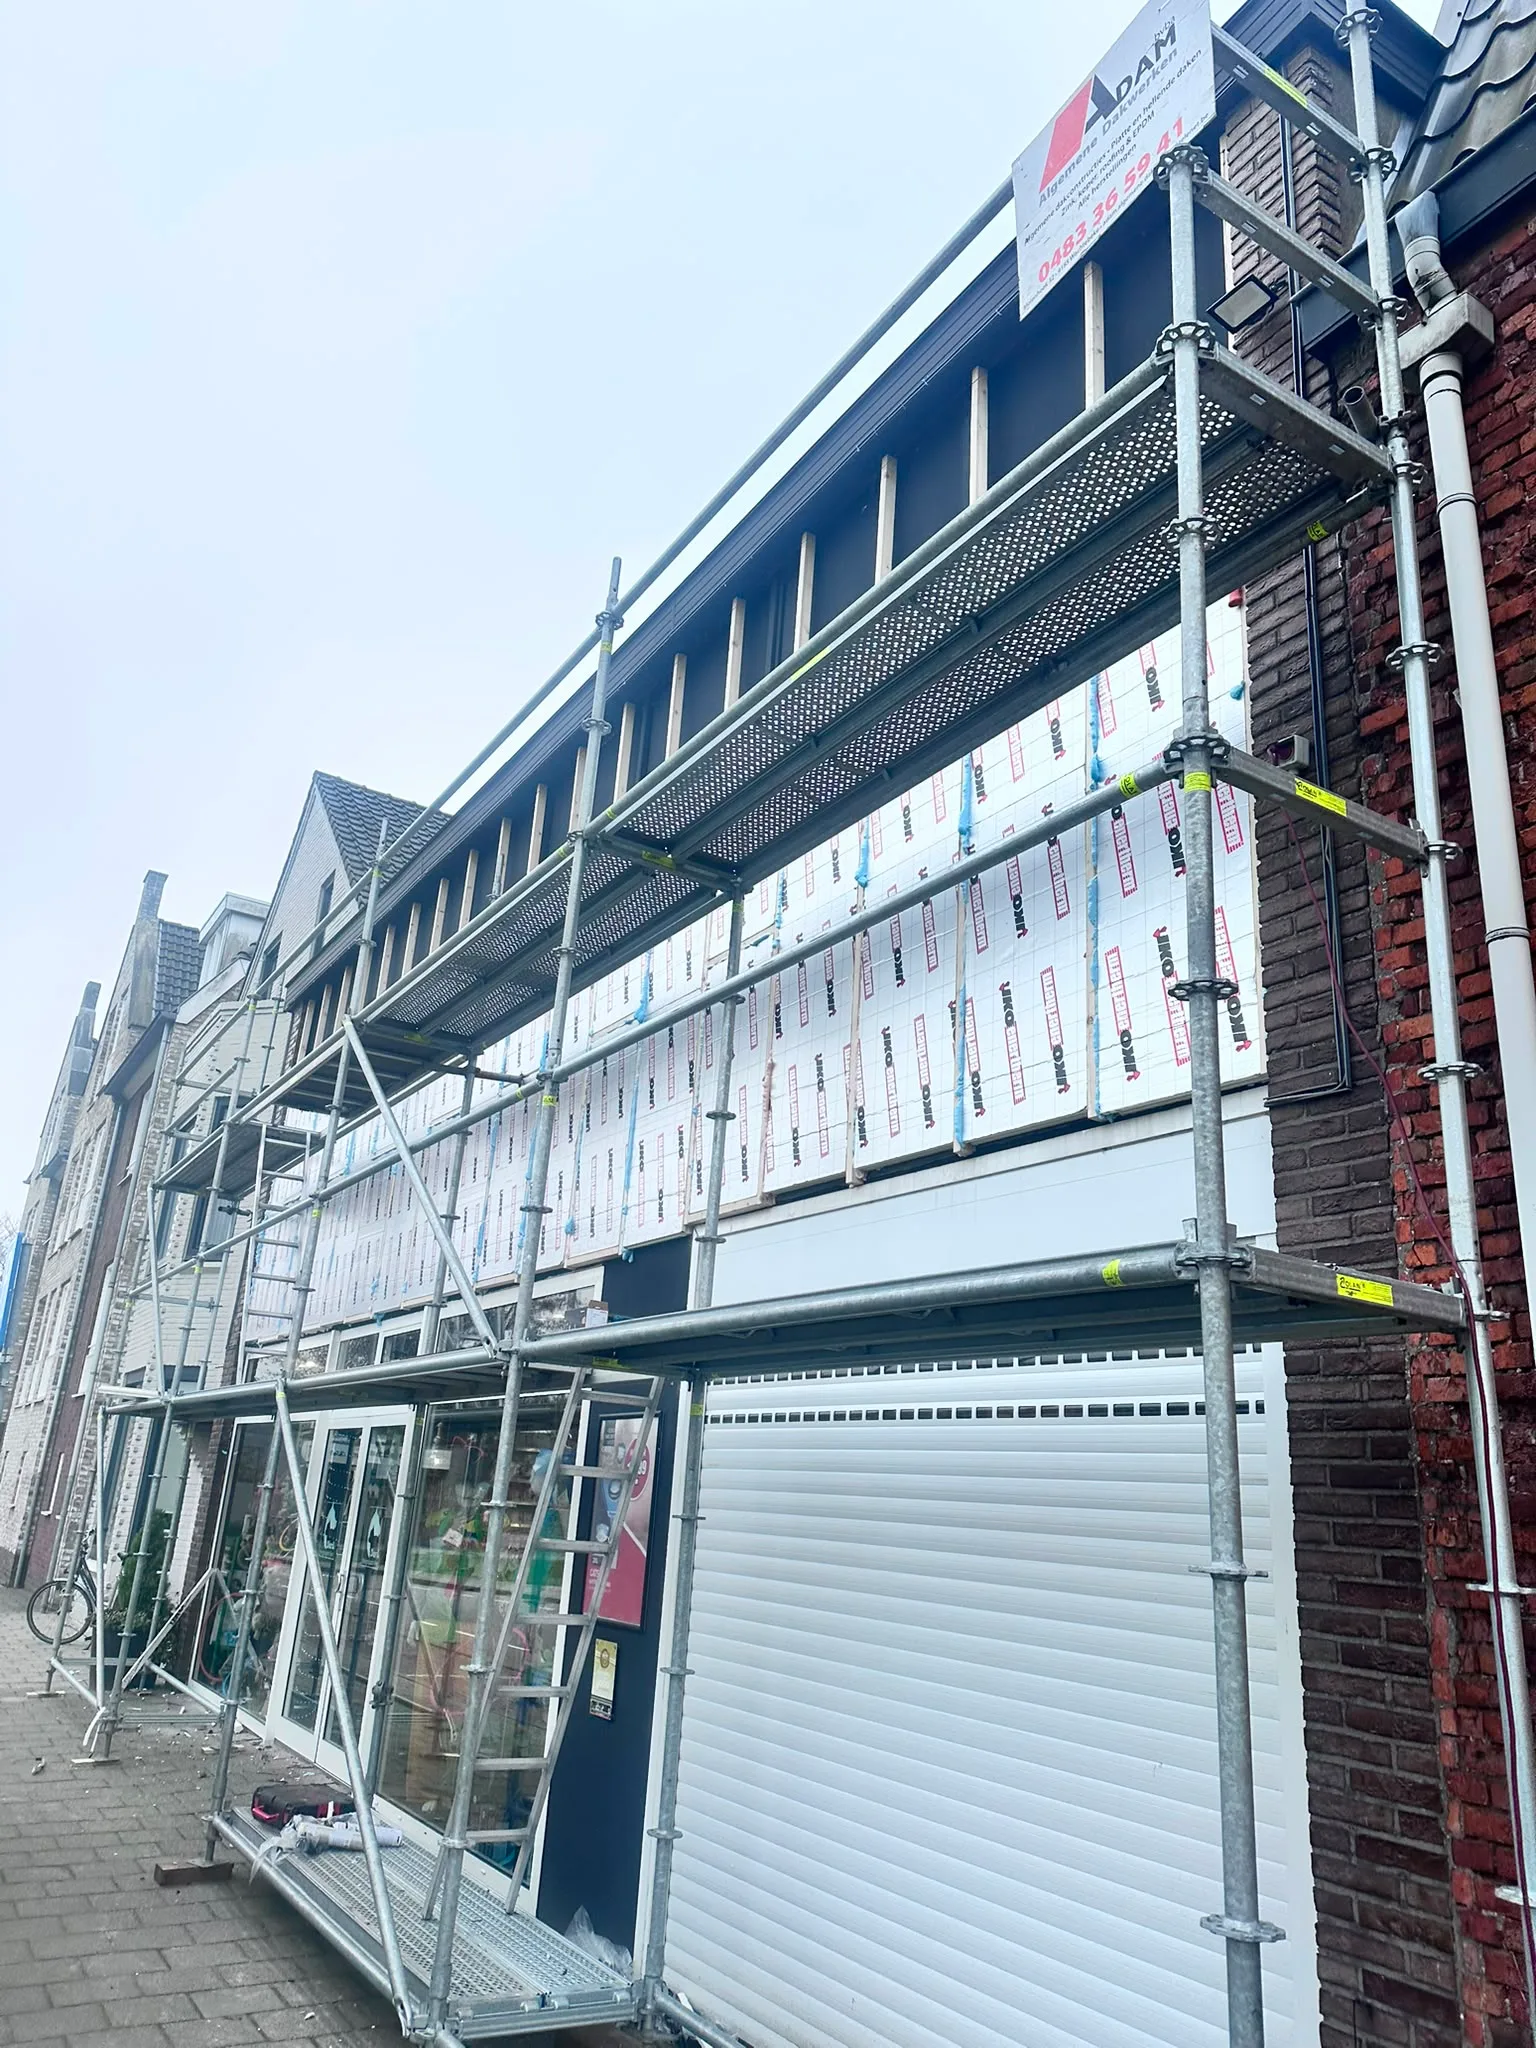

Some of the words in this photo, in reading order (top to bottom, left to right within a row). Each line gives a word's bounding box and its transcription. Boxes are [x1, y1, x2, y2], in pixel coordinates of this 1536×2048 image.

[1154, 16, 1175, 41] bvba
[1084, 23, 1176, 135] ADAM
[1039, 138, 1097, 207] Algemene
[1103, 48, 1177, 136] Dakwerken
[1126, 136, 1132, 146] &
[1133, 110, 1154, 139] EPDM
[1024, 208, 1054, 244] Algemene
[1055, 154, 1105, 211] dakconstructies
[1111, 128, 1131, 149] Platte
[1132, 113, 1141, 127] en
[1142, 76, 1175, 115] hellende
[1177, 50, 1201, 78] daken
[1078, 193, 1090, 210] Alle
[1091, 143, 1137, 195] herstellingen
[1038, 220, 1087, 283] 0483
[1092, 186, 1118, 227] 36
[1124, 152, 1150, 195] 59
[1157, 115, 1183, 156] 41
[1051, 718, 1063, 753] IKO
[975, 764, 986, 798] IKO
[903, 805, 913, 838] IKO
[1168, 827, 1186, 869] IKO
[1013, 894, 1025, 931] IKO
[894, 948, 904, 981] IKO
[1157, 934, 1174, 977] IKO
[827, 980, 835, 1011] IKO
[1002, 989, 1014, 1028] IKO
[1227, 996, 1248, 1042] IKO
[883, 1032, 892, 1067] IKO
[1053, 1045, 1067, 1086] IKO
[1120, 1030, 1137, 1072] IKO
[816, 1060, 824, 1092] IKO
[971, 1071, 984, 1109] IKO
[922, 1085, 933, 1121] IKO
[858, 1106, 867, 1141] IKO
